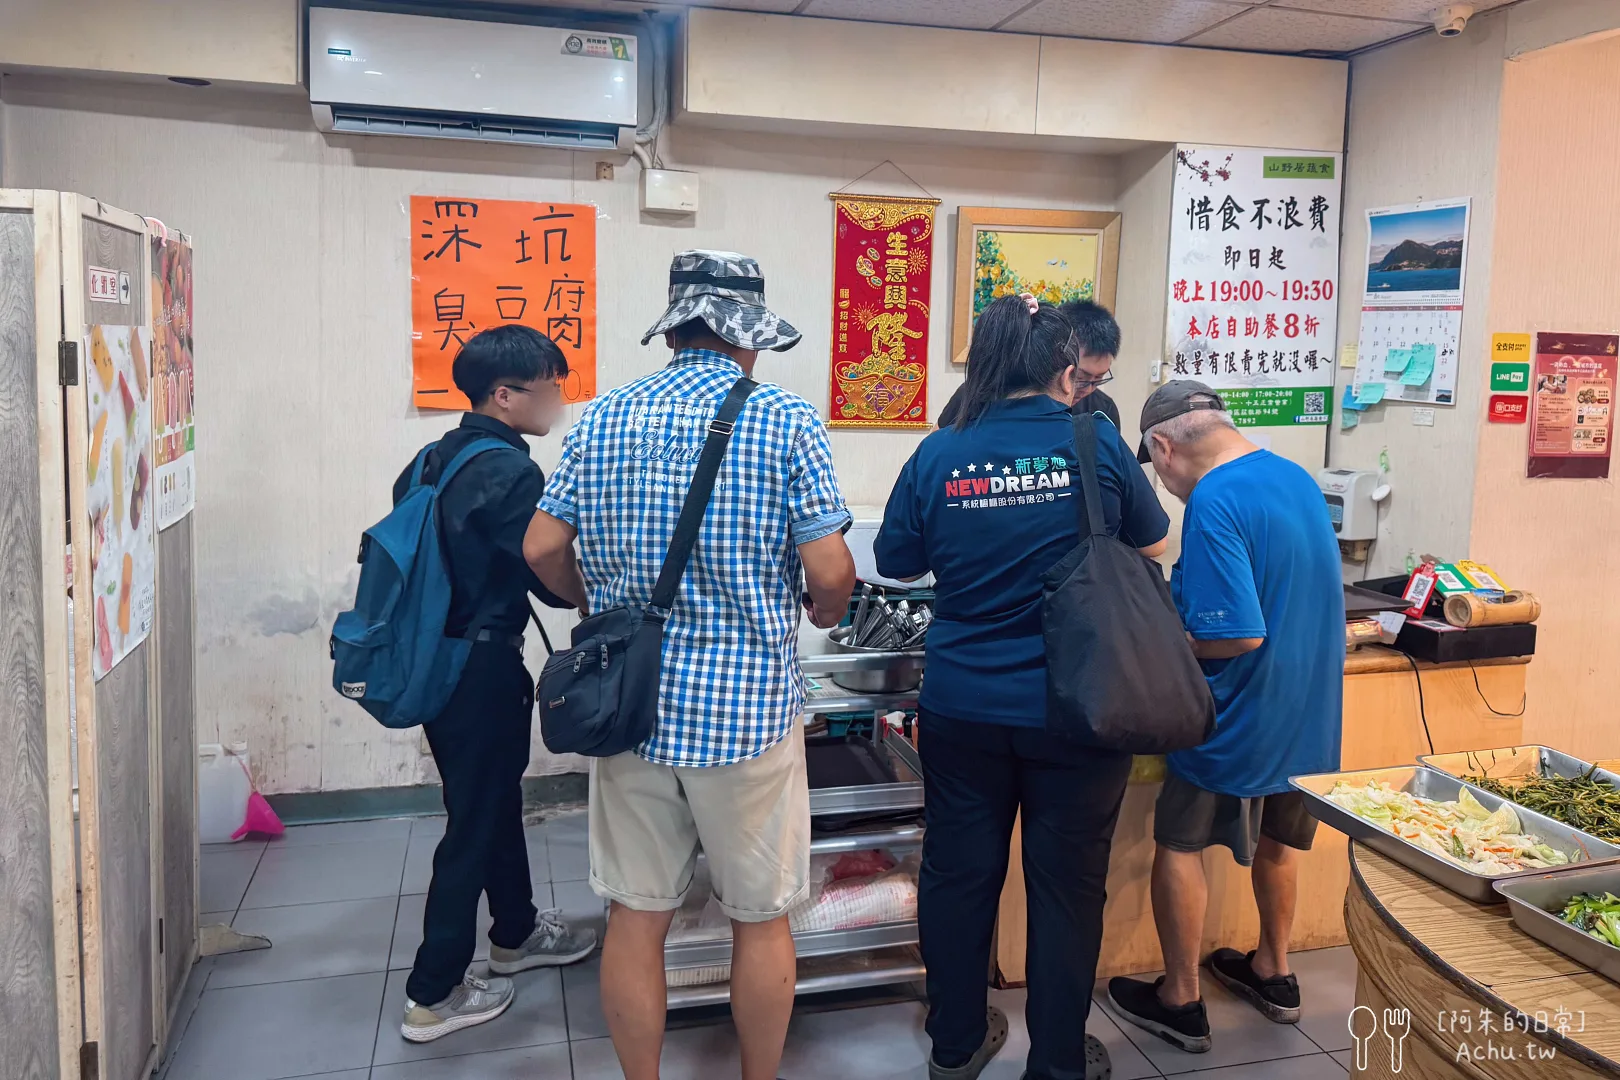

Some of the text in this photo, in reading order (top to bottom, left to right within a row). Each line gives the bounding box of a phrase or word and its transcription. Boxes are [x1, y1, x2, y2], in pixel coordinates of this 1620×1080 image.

[1269, 162, 1330, 174] 山野居蔬食
[1186, 195, 1330, 233] 惜食不浪費
[421, 200, 574, 264] 深坑
[1224, 245, 1287, 271] 即日起
[866, 231, 924, 361] 生意興隆
[1187, 313, 1320, 340] 本店自助餐8折
[1496, 342, 1515, 352] 全支付
[630, 429, 707, 463] Edwi
[1015, 456, 1067, 475] 新夢想
[622, 476, 650, 489] STYLE
